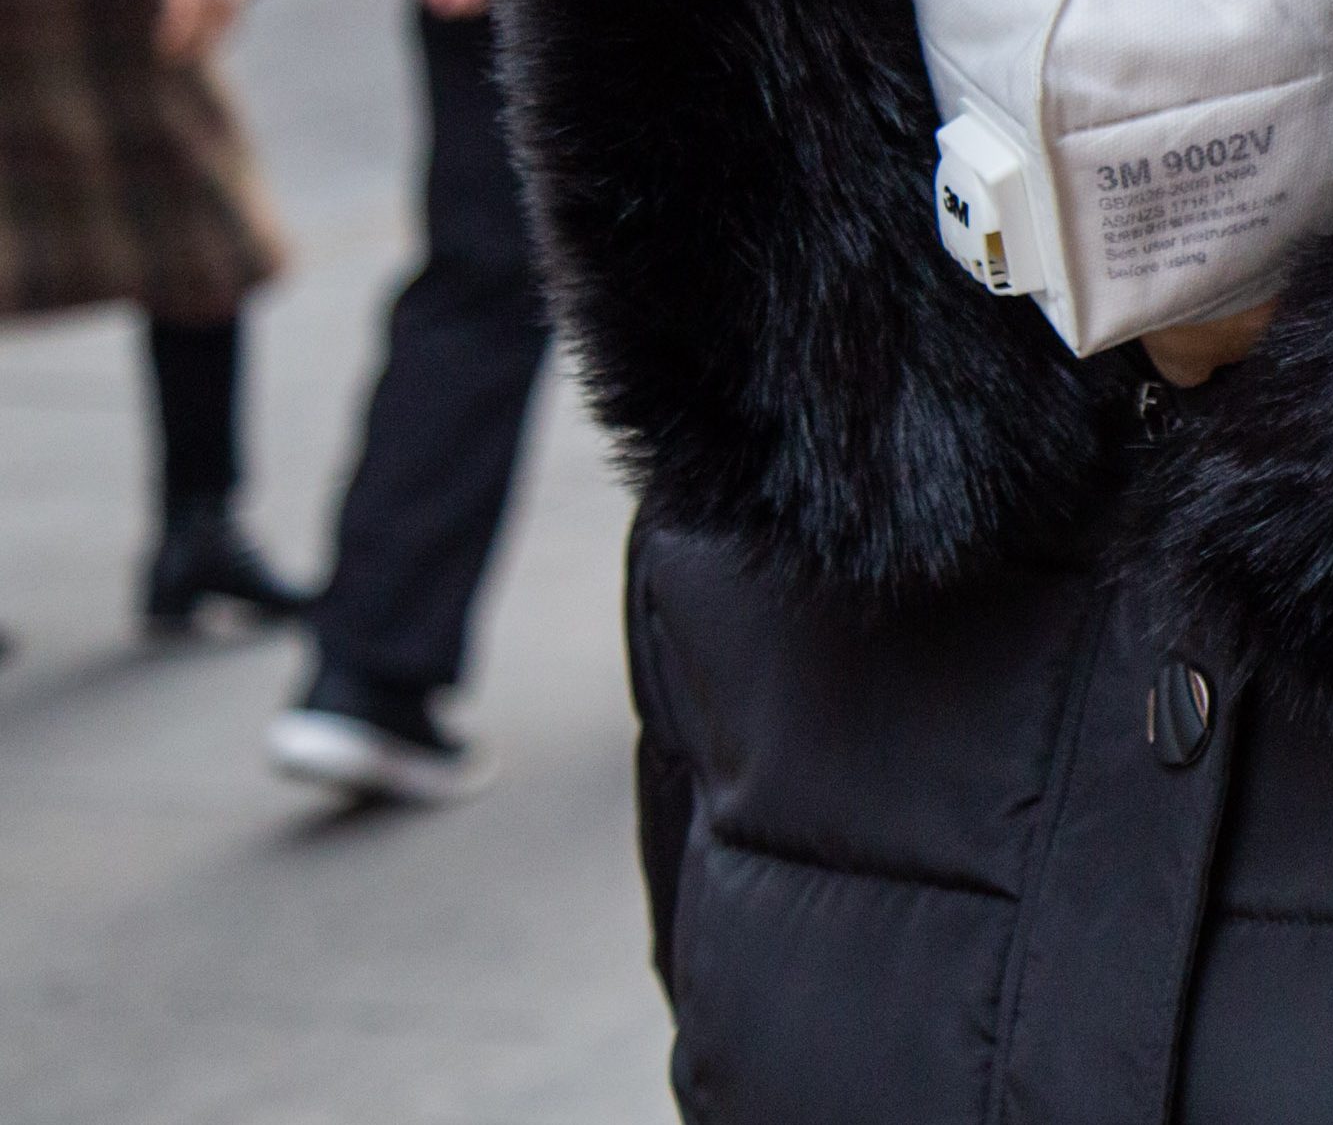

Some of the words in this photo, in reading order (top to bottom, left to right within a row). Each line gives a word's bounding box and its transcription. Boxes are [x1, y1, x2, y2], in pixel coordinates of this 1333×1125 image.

[1097, 158, 1151, 191] 3M
[1162, 125, 1275, 176] 9002V
[943, 185, 969, 229] 3M
